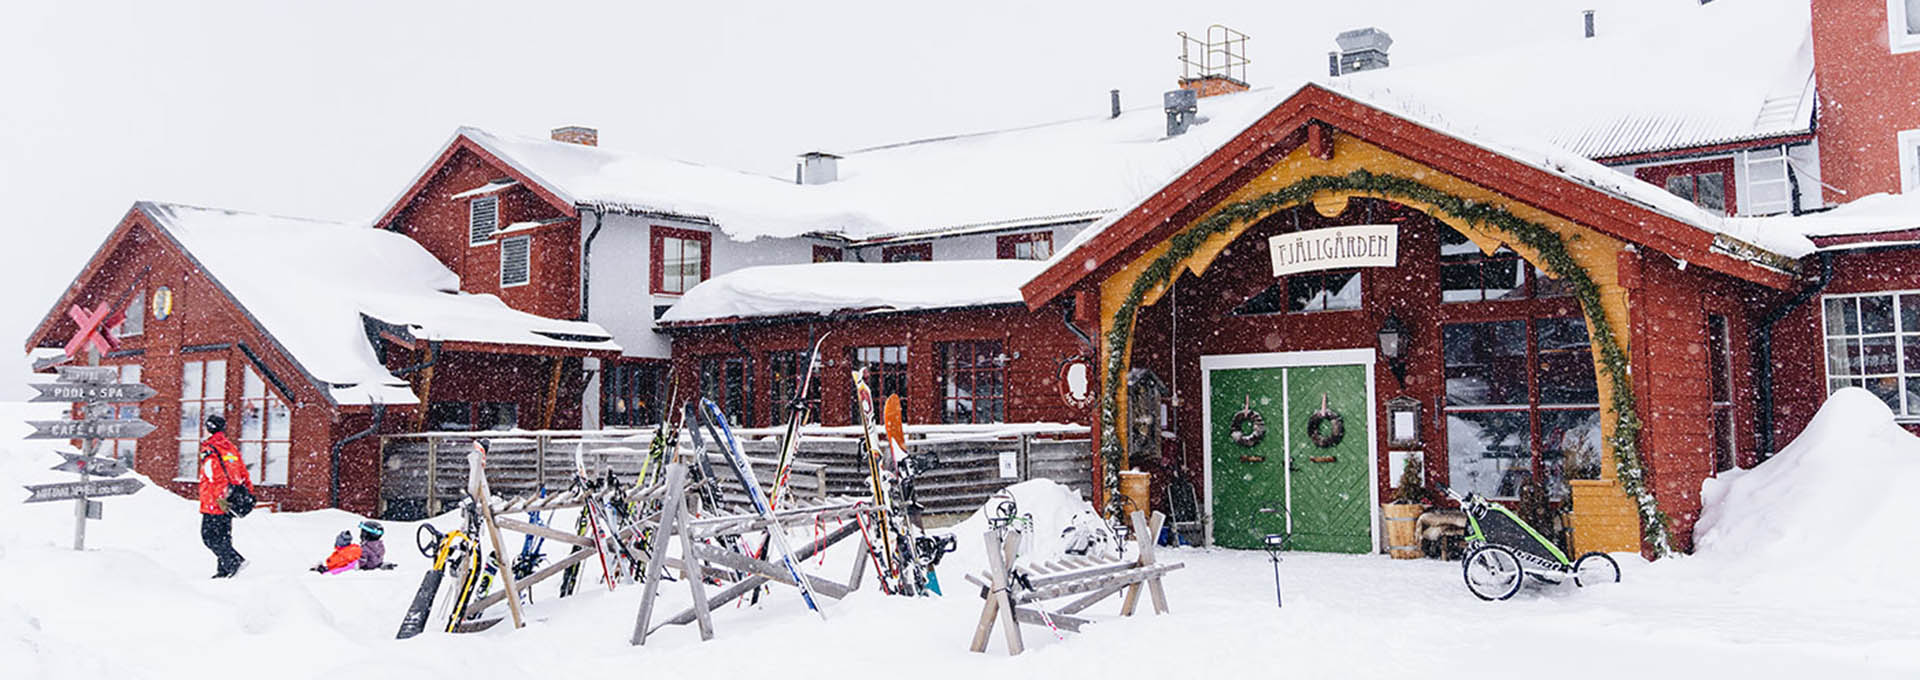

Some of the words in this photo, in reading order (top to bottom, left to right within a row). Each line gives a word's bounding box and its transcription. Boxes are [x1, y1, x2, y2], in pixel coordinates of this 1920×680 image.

[1278, 231, 1389, 266] FJÄLLGÅRDEN
[54, 387, 84, 398] POOL
[99, 387, 124, 398] SPA
[1512, 546, 1562, 571] hariot
